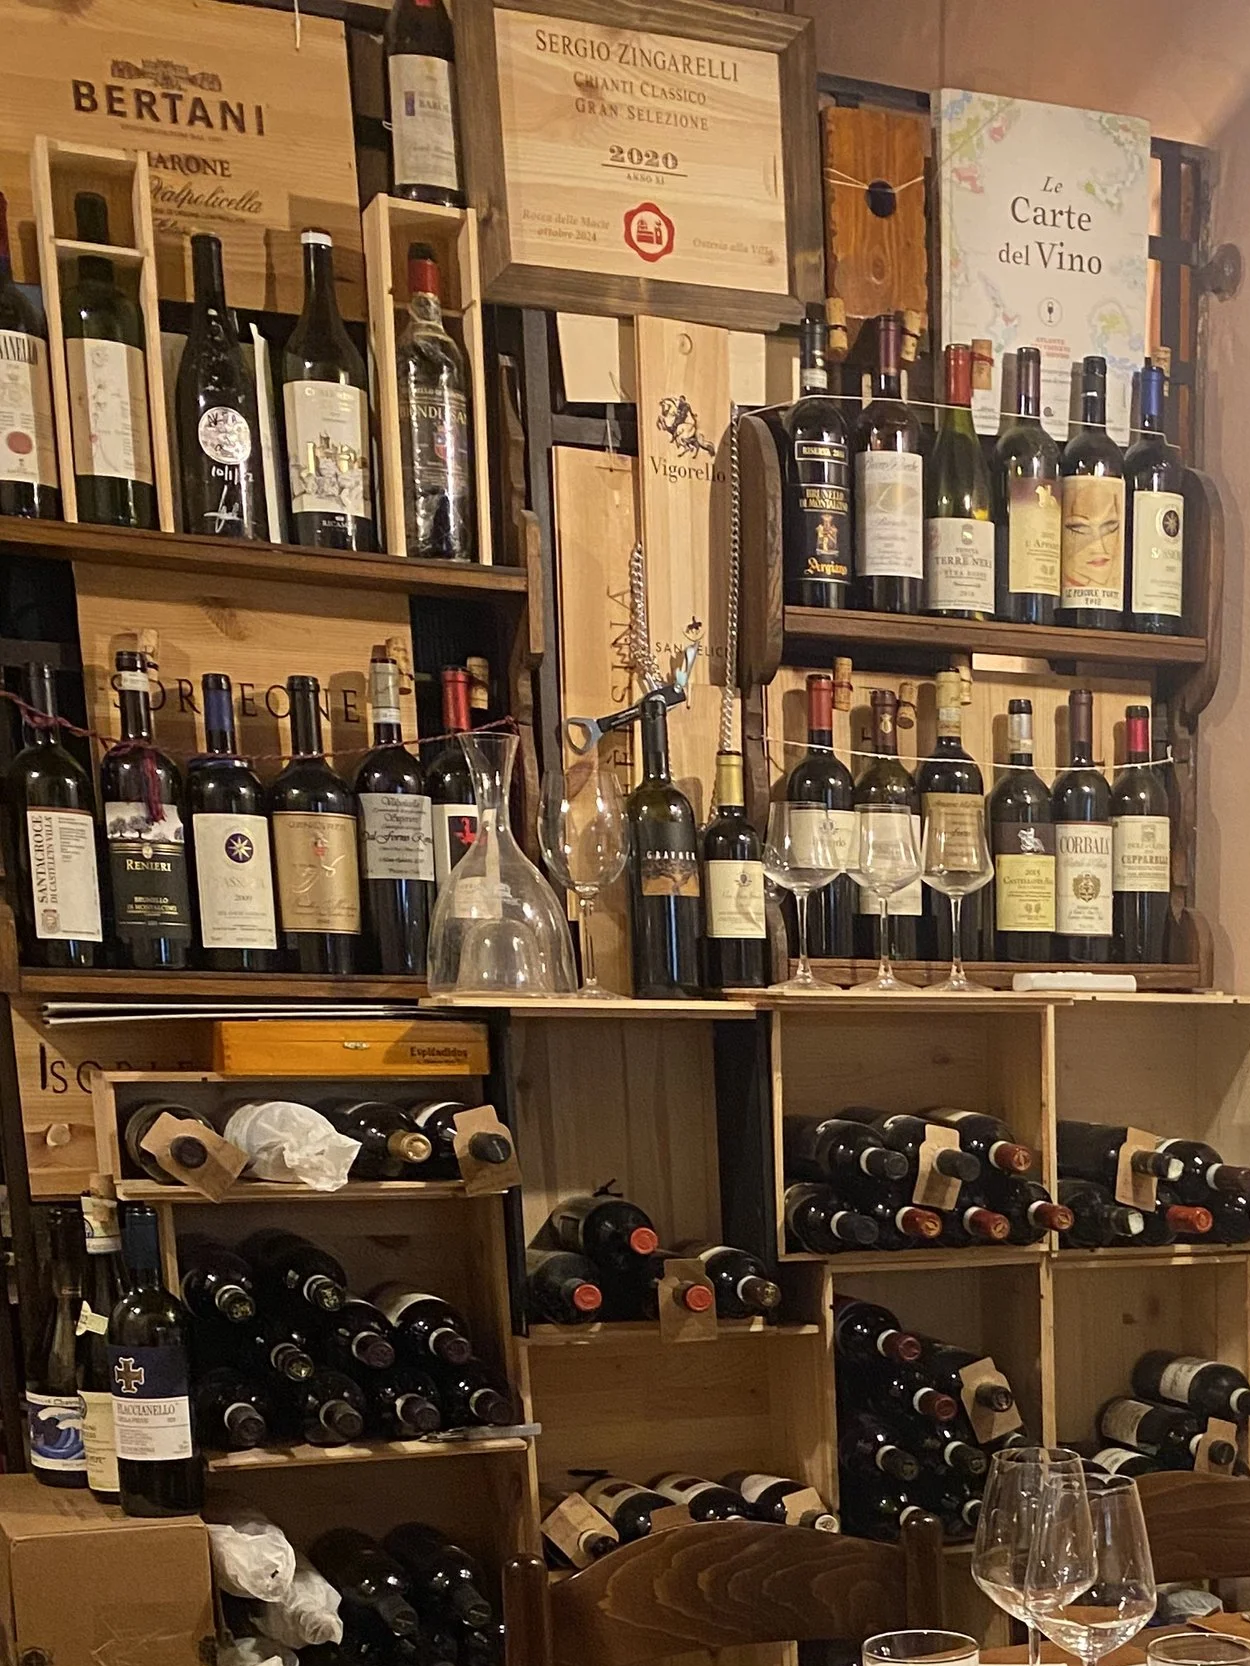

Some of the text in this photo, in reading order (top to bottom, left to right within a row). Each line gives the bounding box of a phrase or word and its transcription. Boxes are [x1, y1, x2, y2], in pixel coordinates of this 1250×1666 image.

[535, 29, 739, 83] SERGIO ZINGARELLI
[573, 71, 707, 106] CHIANTI CLASSICO
[72, 79, 265, 137] BERTANI
[575, 97, 709, 131] GRAN SELEZIONE
[124, 148, 233, 178] ARONE
[609, 144, 679, 170] 2020
[1040, 175, 1064, 194] Le
[1011, 196, 1093, 232] Carte
[998, 240, 1103, 276] del Vino
[650, 456, 727, 483] Vigorello
[935, 556, 969, 566] TERRE
[655, 641, 729, 659] SAN ELIC
[31, 814, 49, 904] SANTACROCE
[126, 858, 172, 872] RENIERI
